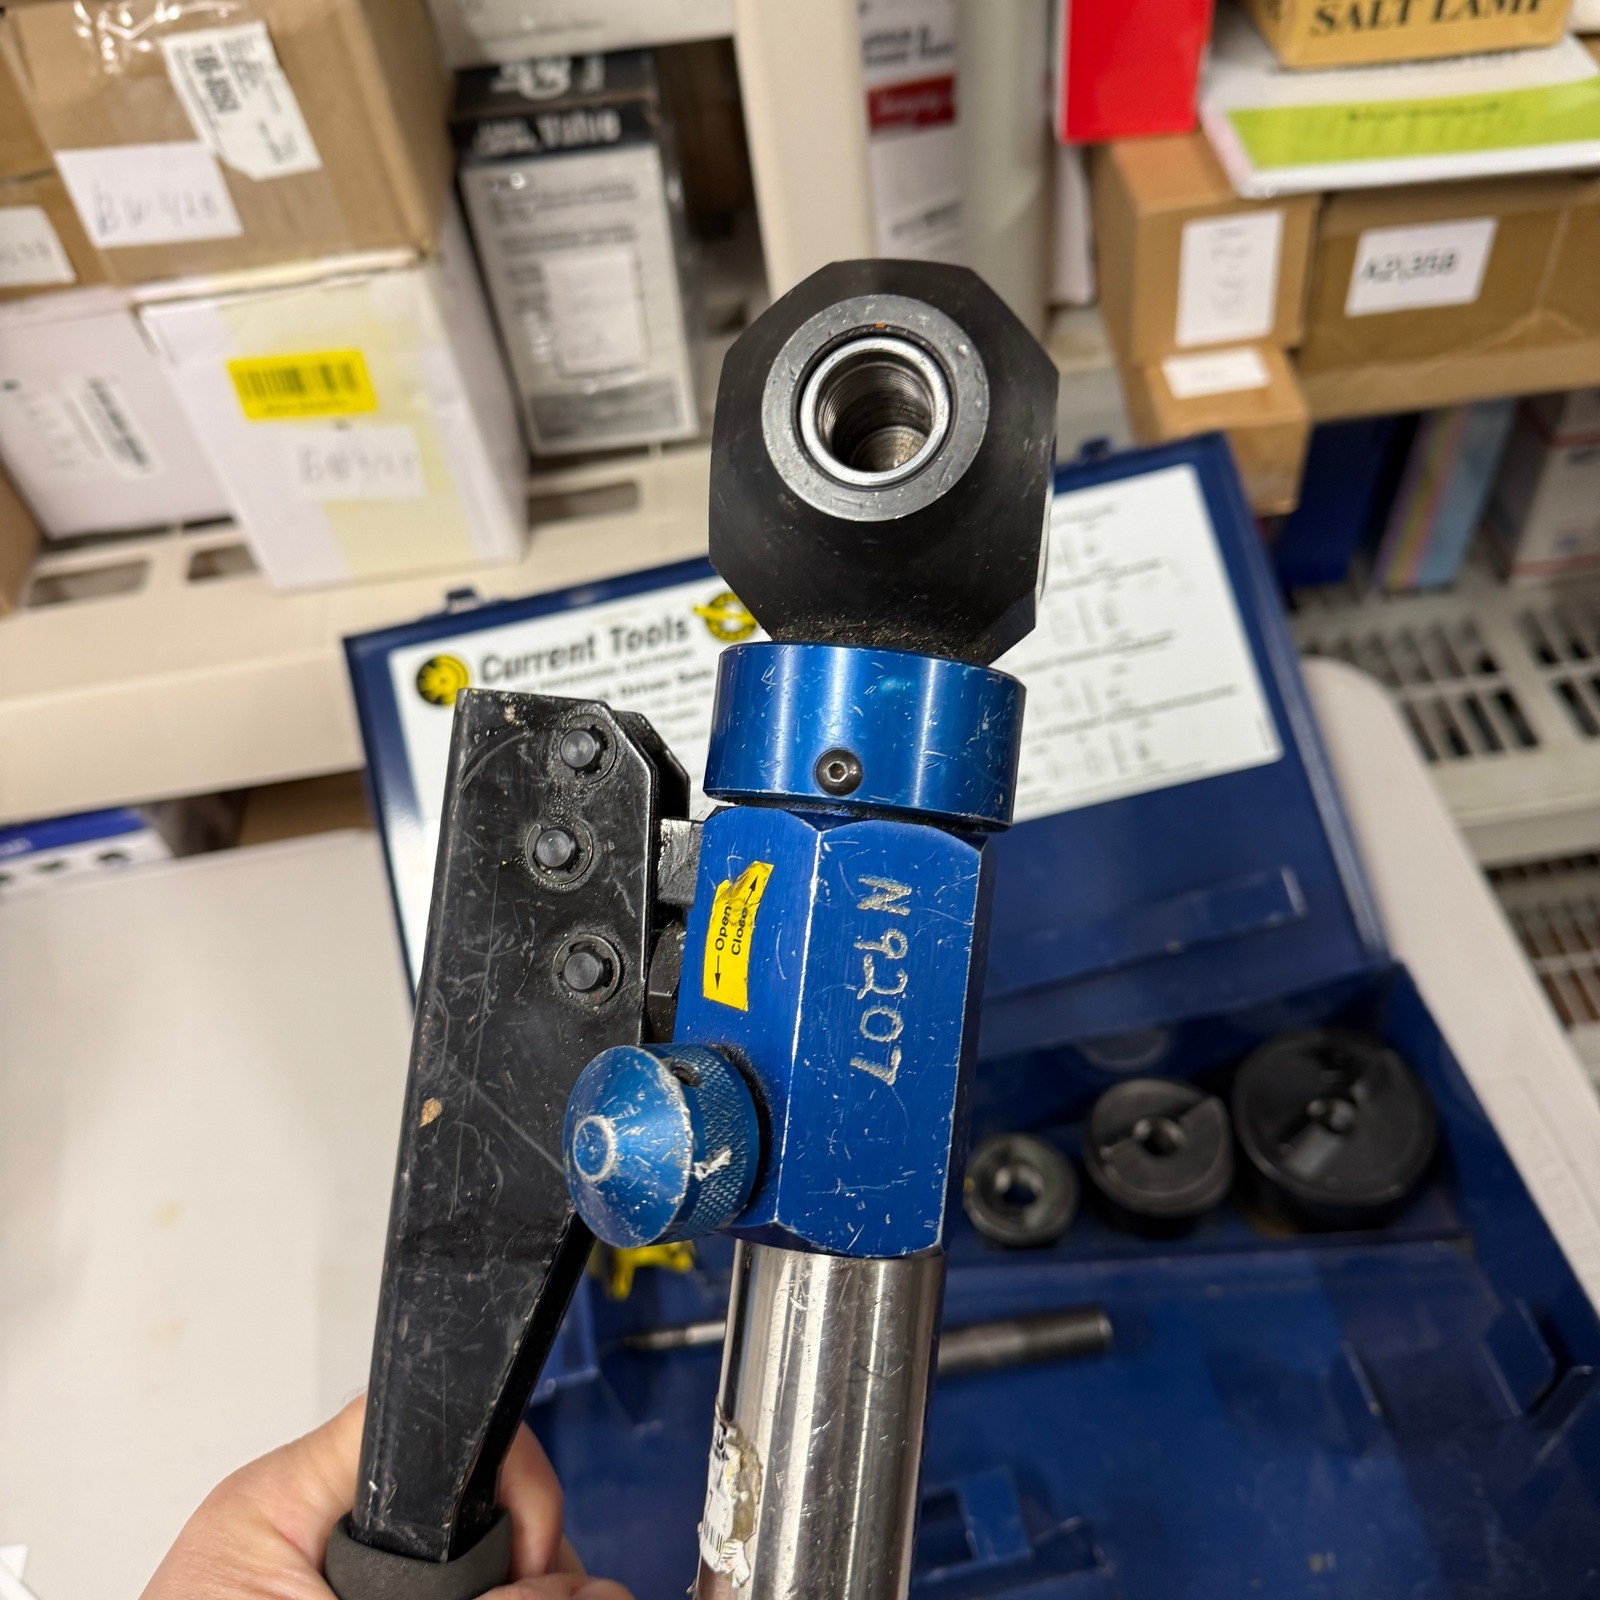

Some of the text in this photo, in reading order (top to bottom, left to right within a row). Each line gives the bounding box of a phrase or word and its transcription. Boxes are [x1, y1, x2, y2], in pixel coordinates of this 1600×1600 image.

[1307, 0, 1411, 37] SALT
[481, 633, 595, 683] Current
[610, 616, 690, 653] Tools
[715, 905, 732, 951] Open
[731, 906, 749, 956] Close
